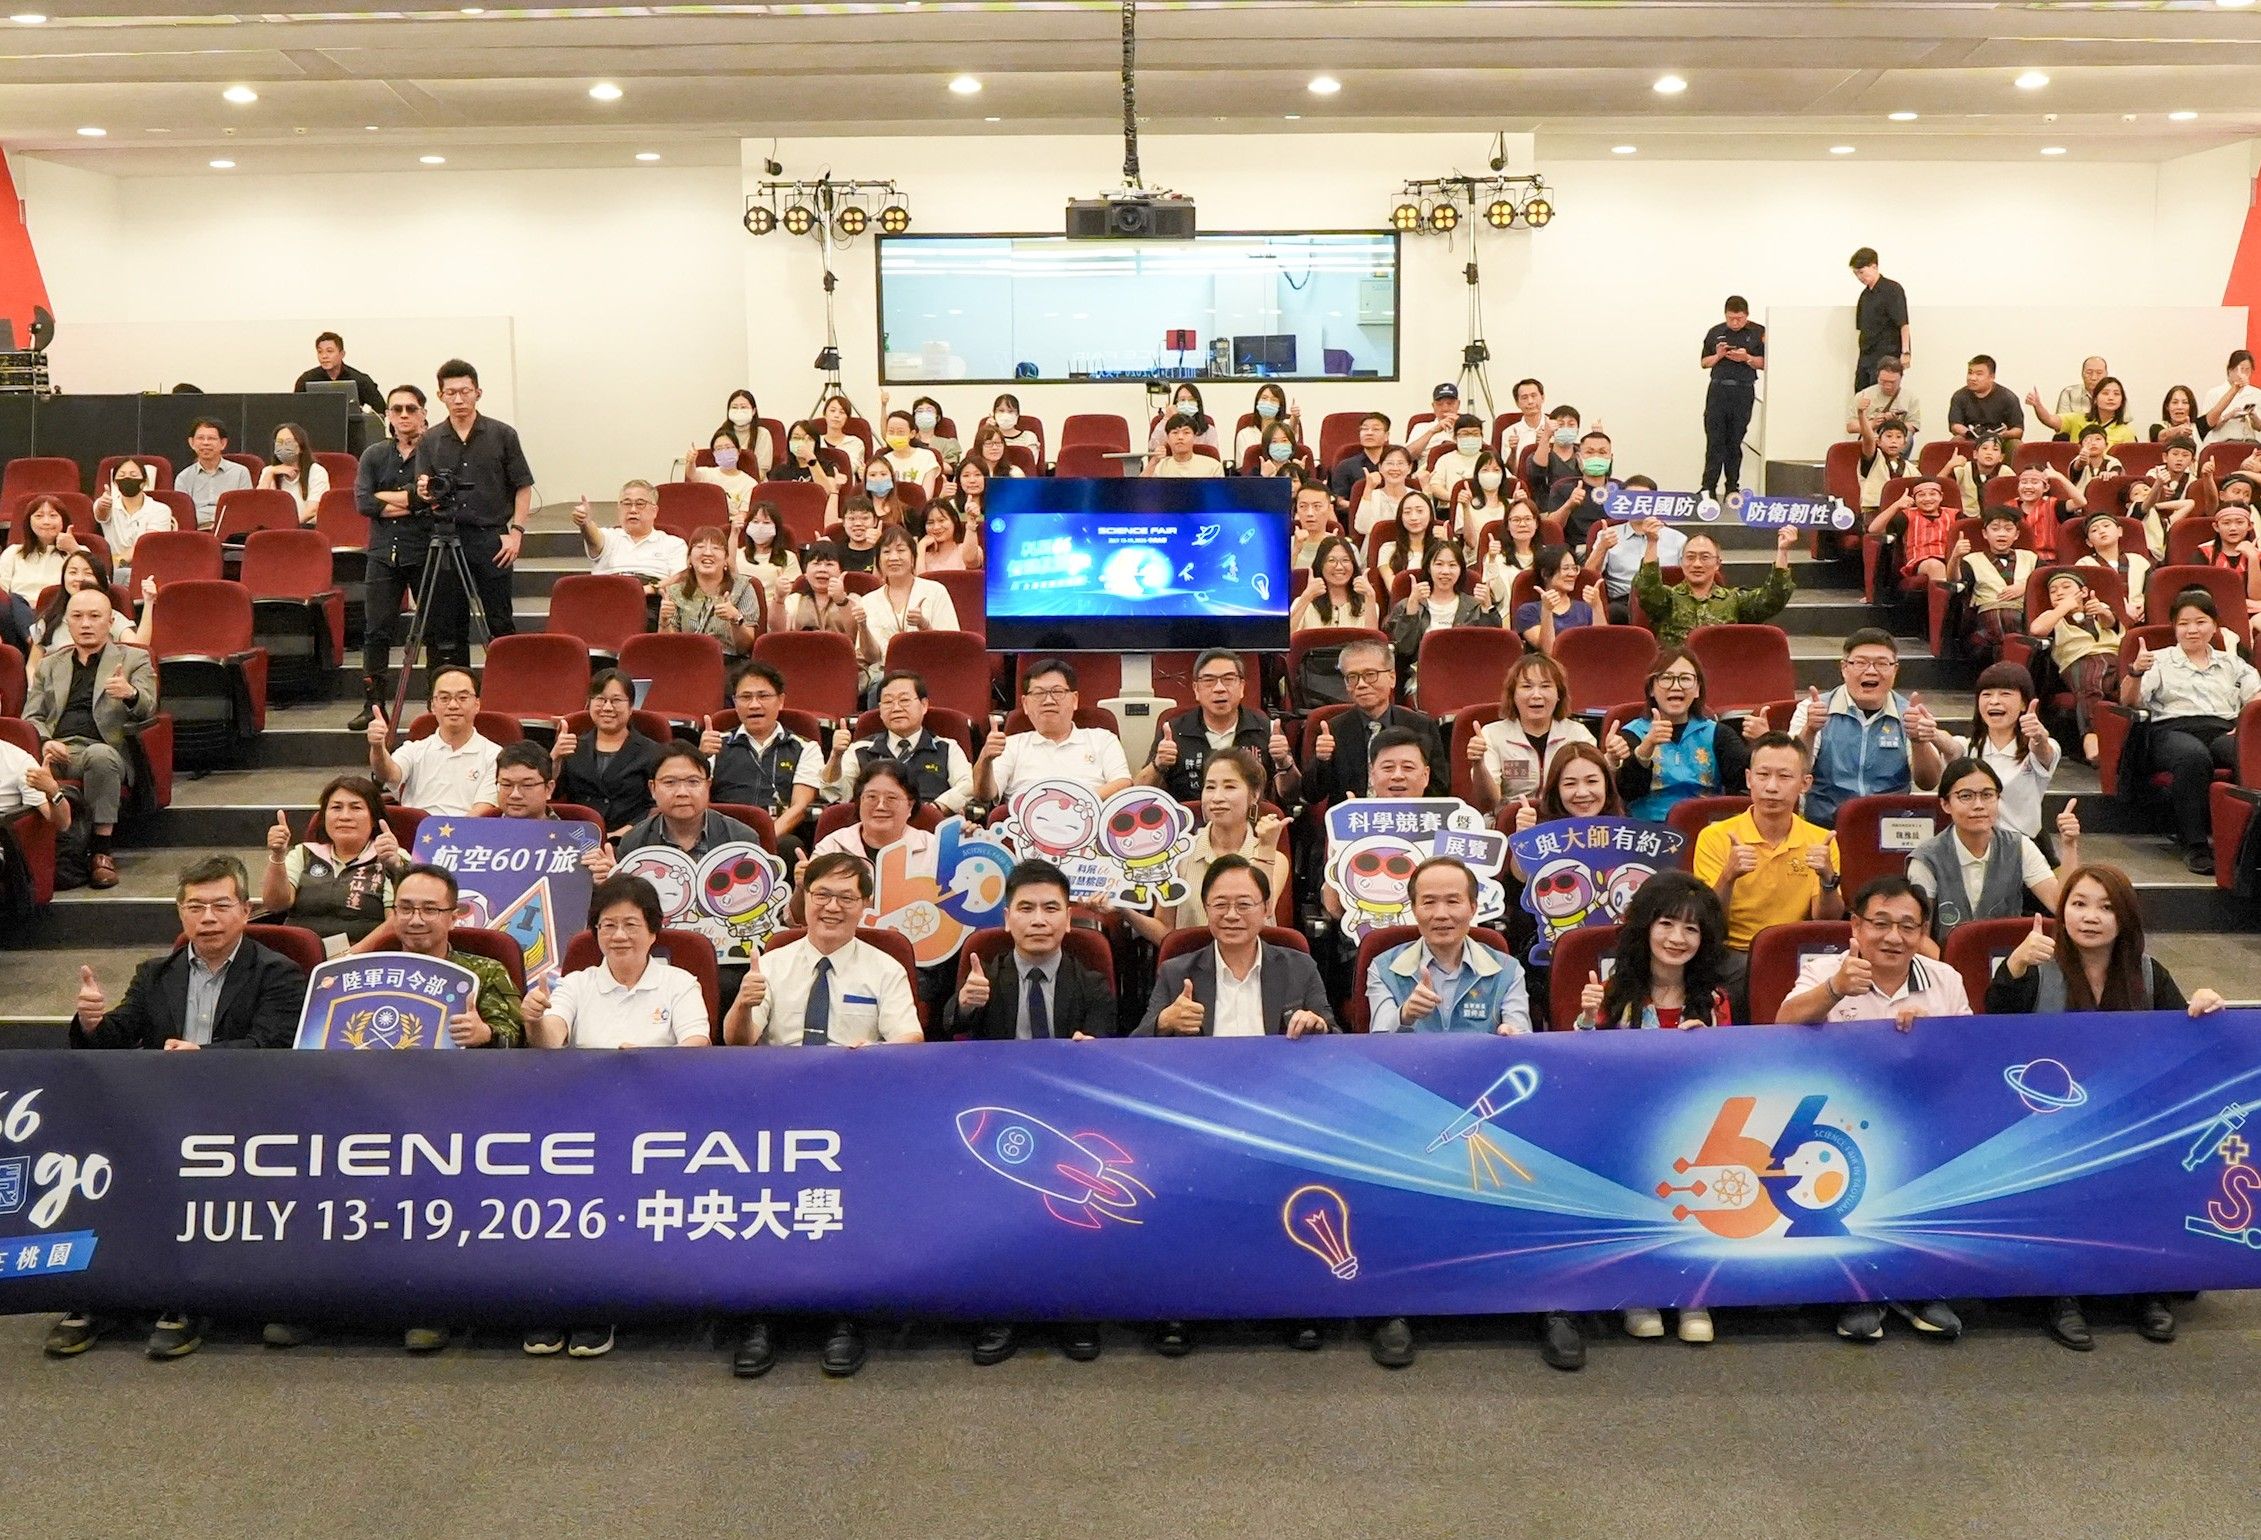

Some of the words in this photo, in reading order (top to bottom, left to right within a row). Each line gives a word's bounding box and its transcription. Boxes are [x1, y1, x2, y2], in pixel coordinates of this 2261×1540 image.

[1611, 495, 1696, 517] 全民國防
[1746, 501, 1830, 524] 防衛韌性
[1348, 811, 1442, 833] 科學競賽
[1444, 836, 1489, 860] 展覽
[1536, 825, 1663, 858] 與大師有約
[432, 845, 581, 873] 航空601旅
[342, 967, 448, 996] 陸軍司令部
[1813, 1129, 1846, 1148] SCIENCE
[179, 1131, 596, 1177] SCIENCE
[631, 1129, 843, 1174] FAIR
[176, 1200, 295, 1243] JULY
